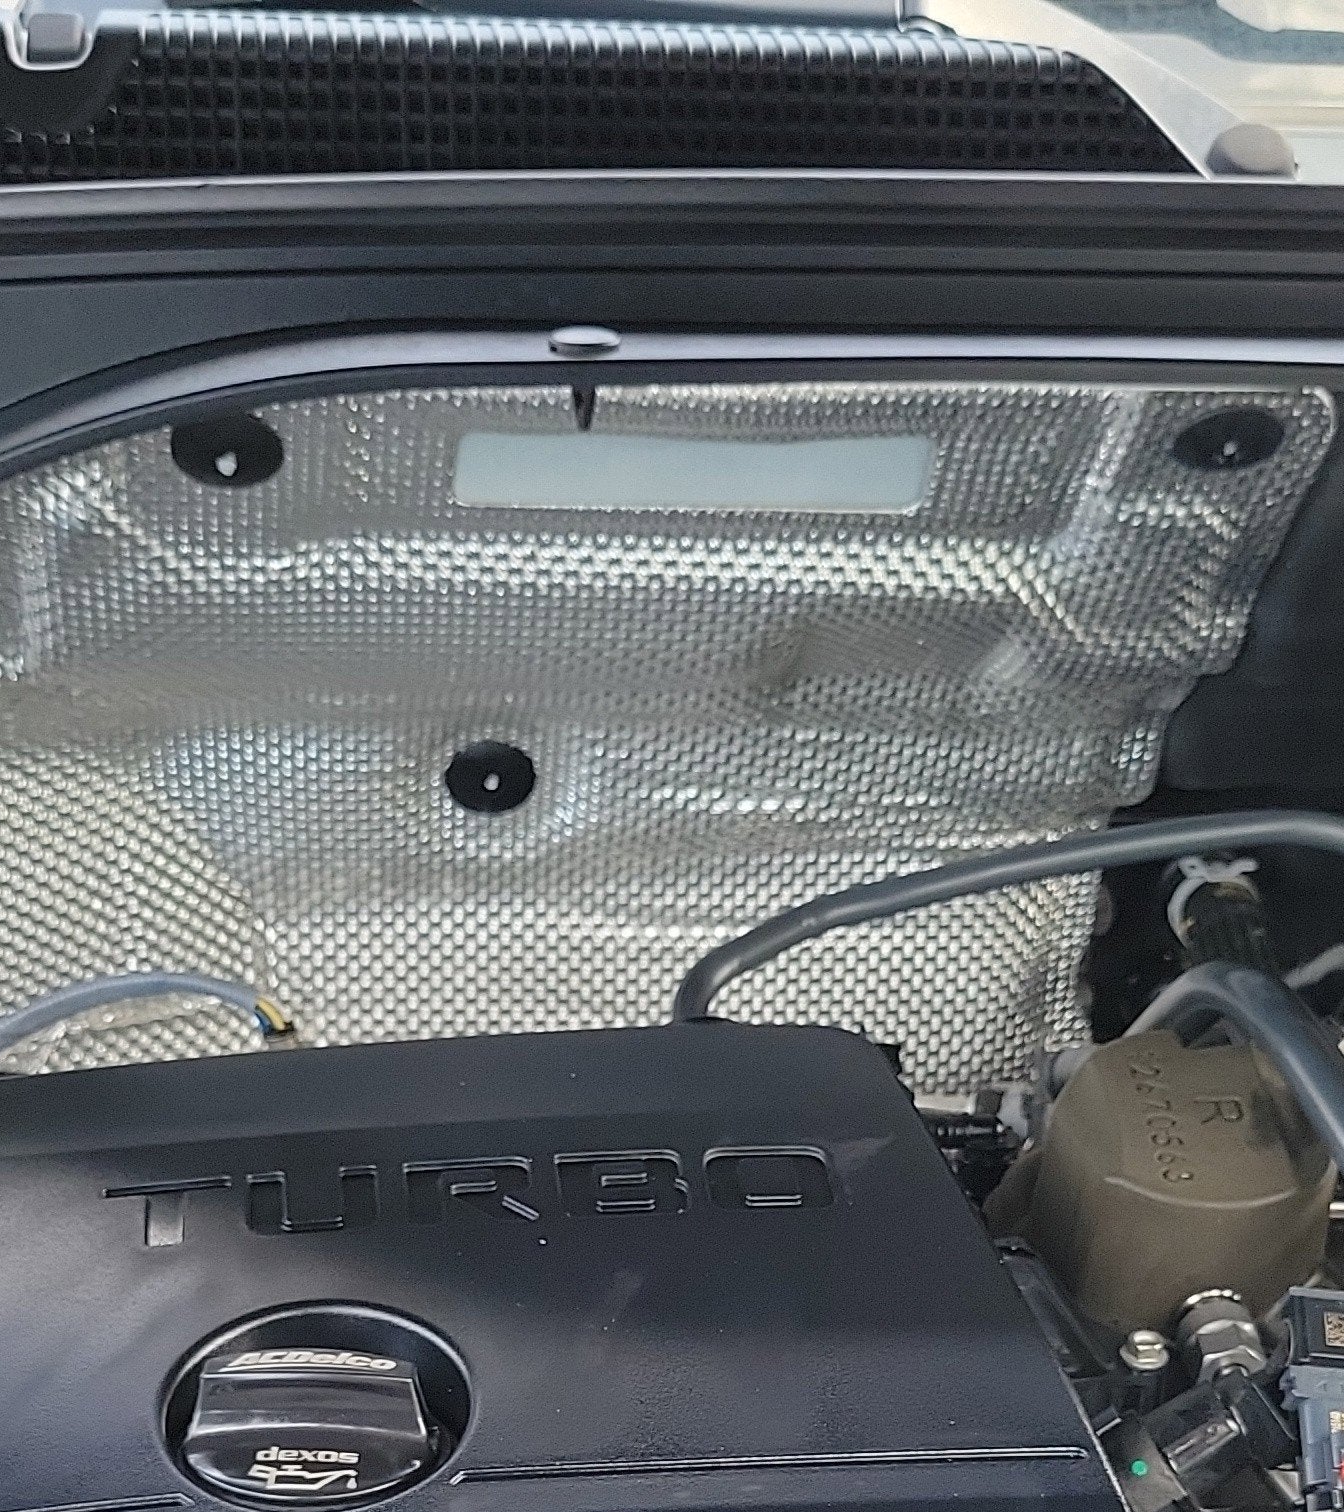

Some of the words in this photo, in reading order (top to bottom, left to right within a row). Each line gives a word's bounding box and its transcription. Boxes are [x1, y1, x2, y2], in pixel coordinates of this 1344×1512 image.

[101, 1144, 836, 1247] TURBO
[226, 1350, 398, 1371] ACDelco
[255, 1446, 360, 1465] dexos
